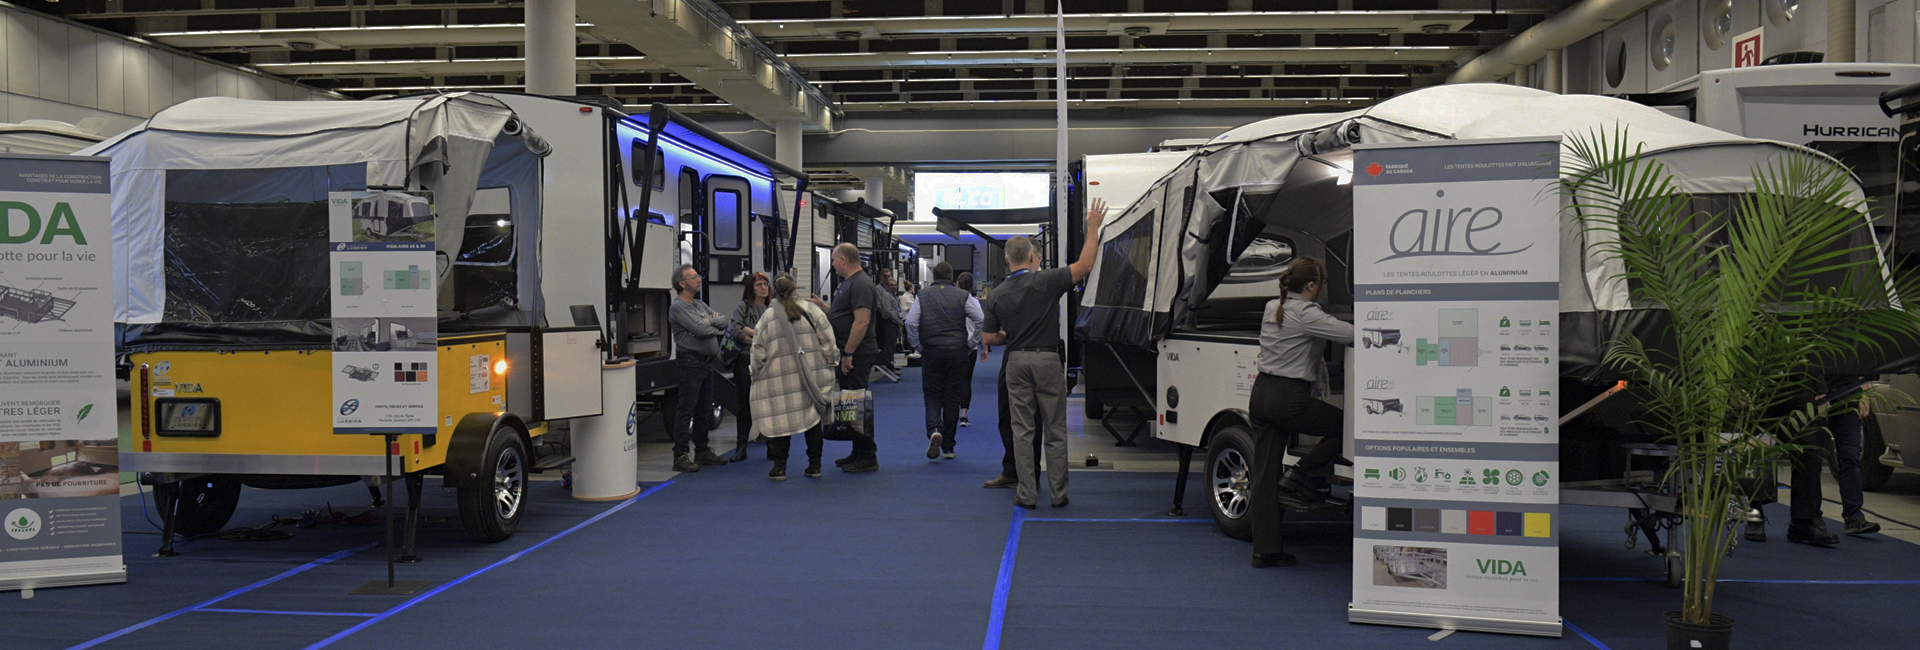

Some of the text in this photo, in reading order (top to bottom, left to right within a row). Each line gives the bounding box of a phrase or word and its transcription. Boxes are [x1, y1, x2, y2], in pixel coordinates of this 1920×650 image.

[1389, 189, 1503, 255] aire
[28, 252, 58, 263] pour
[62, 251, 73, 261] la
[76, 251, 96, 261] vie
[1366, 306, 1388, 320] aire
[1166, 352, 1179, 361] VIDA
[6, 359, 68, 367] ALUMINIUM
[175, 383, 203, 393] VIDA
[1366, 376, 1388, 389] aire
[27, 405, 61, 415] LÉGER
[841, 411, 856, 421] VR
[1476, 559, 1527, 576] VIDA
